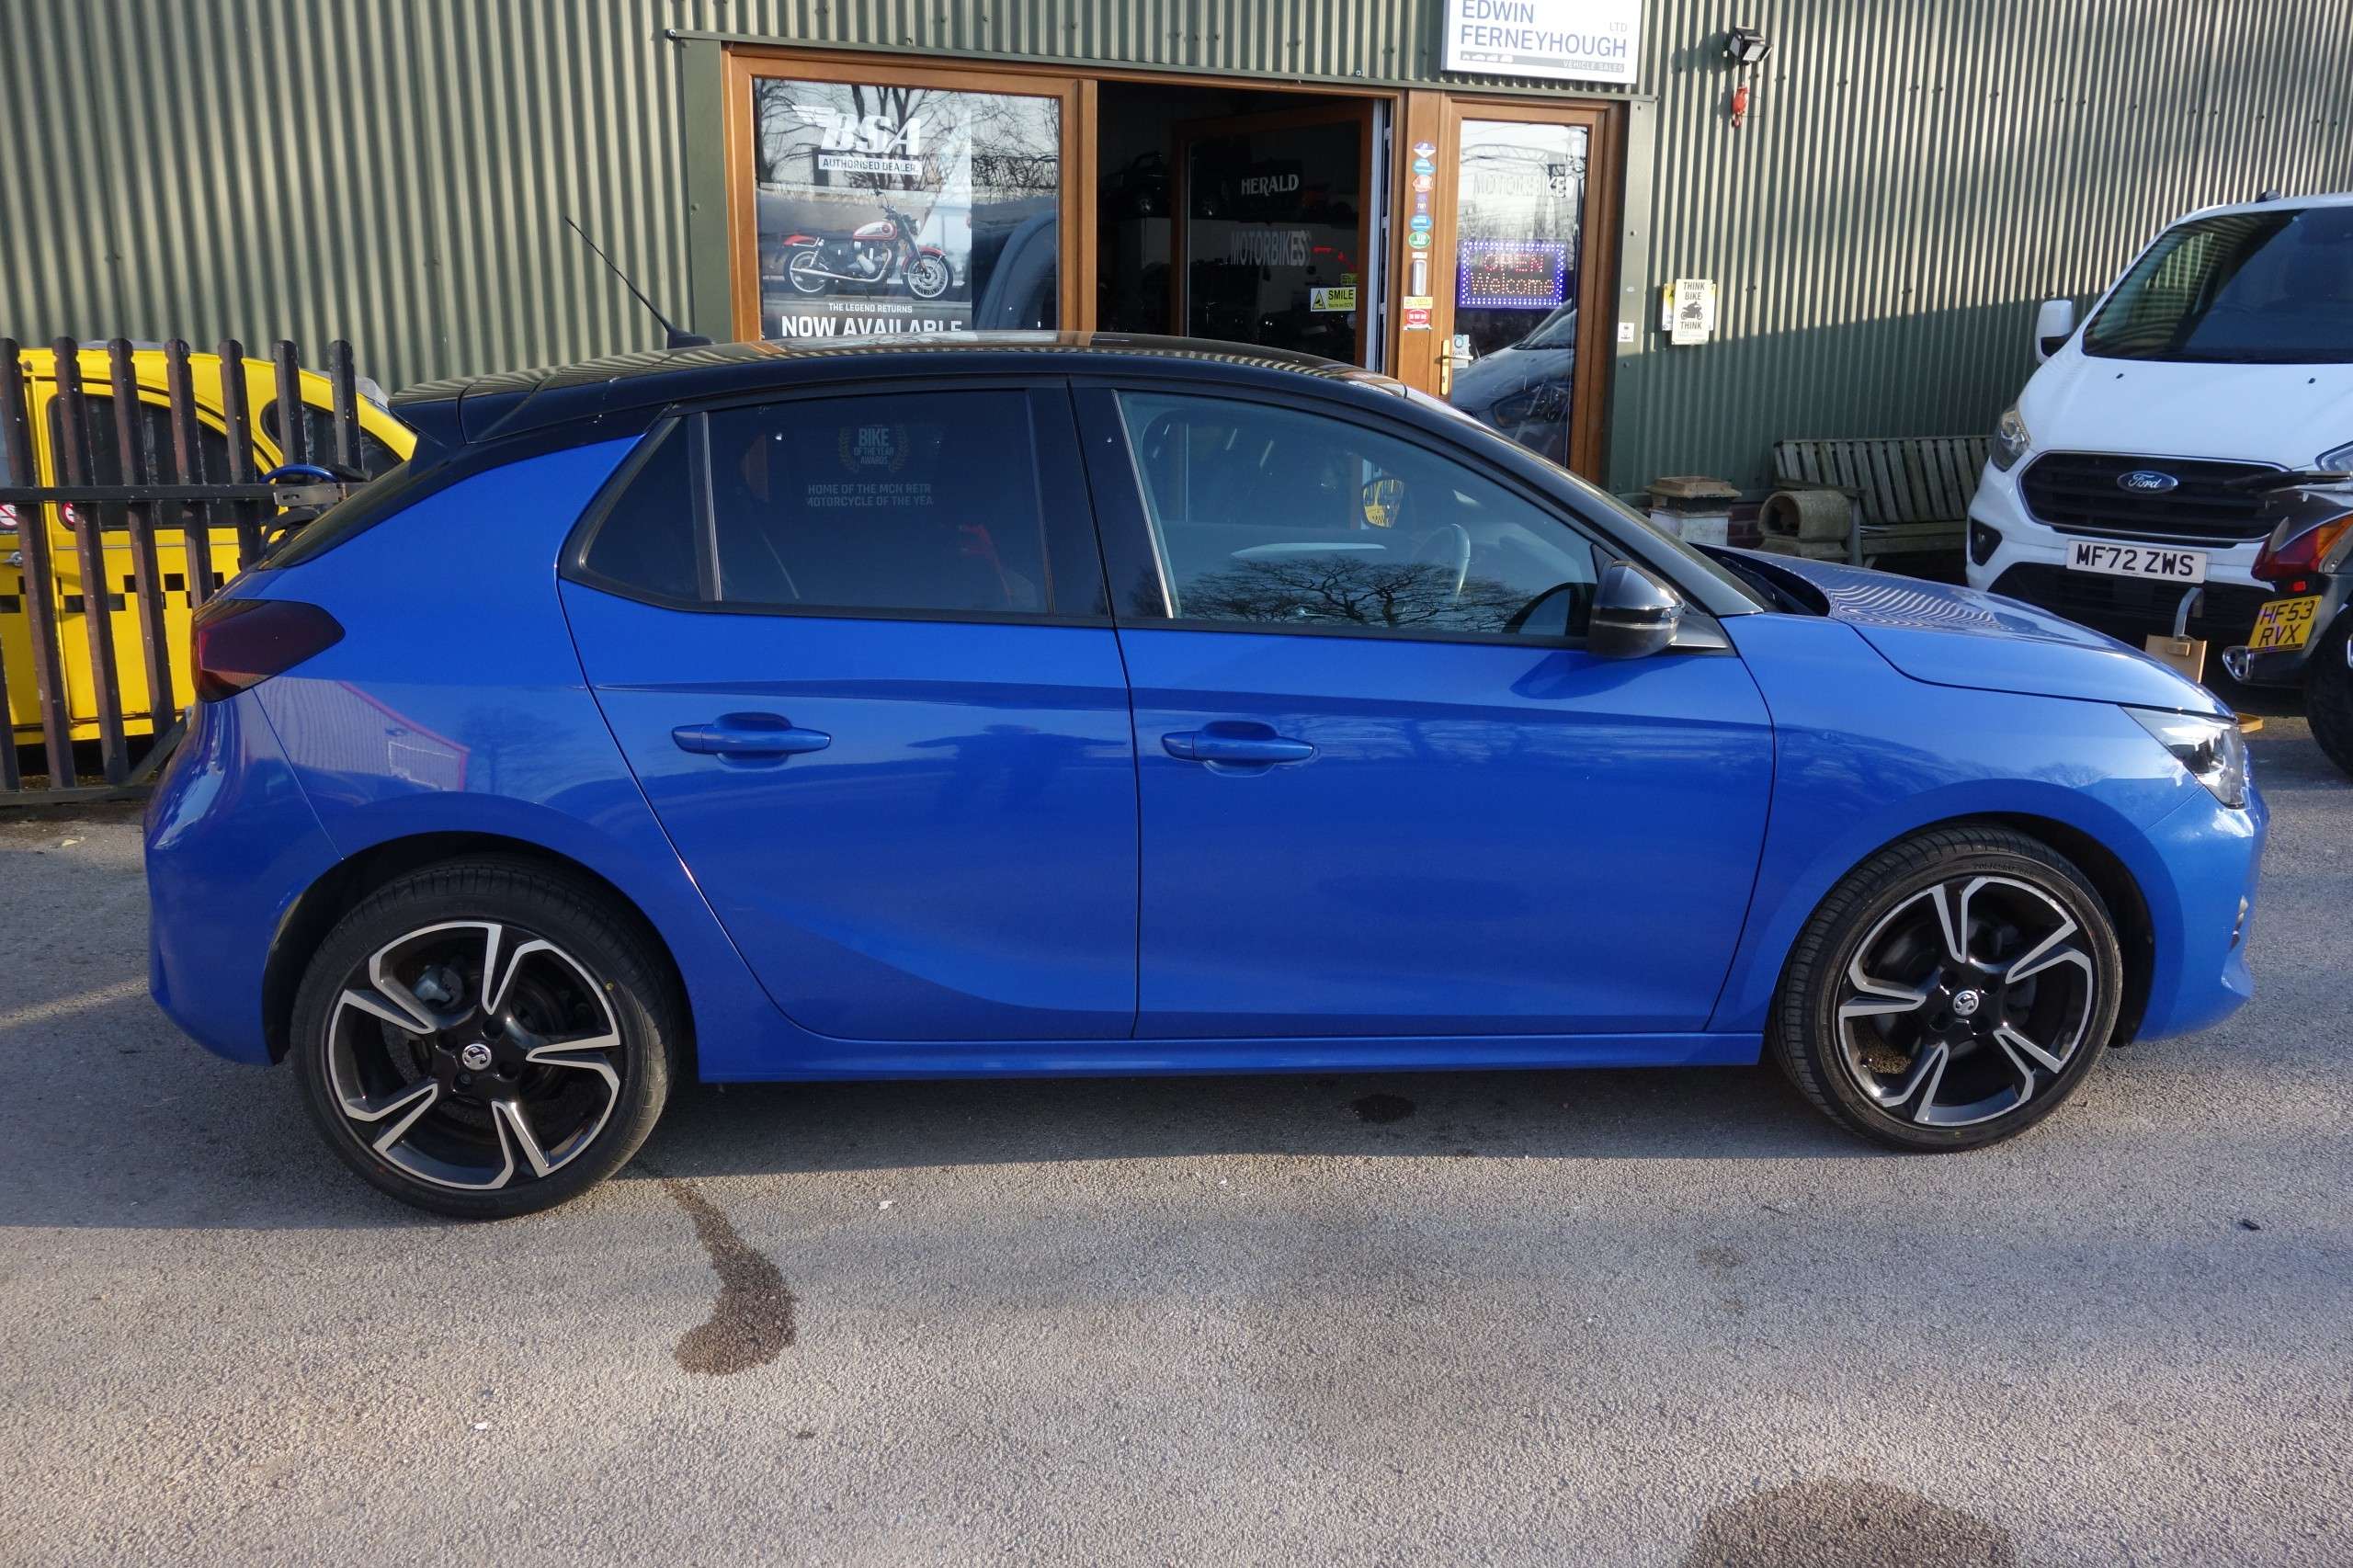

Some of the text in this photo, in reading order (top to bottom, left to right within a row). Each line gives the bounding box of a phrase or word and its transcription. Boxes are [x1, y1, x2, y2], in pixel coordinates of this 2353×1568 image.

[1462, 0, 1534, 23] EDWIN
[1609, 22, 1628, 32] LTD
[1461, 24, 1627, 58] FERNEYHOUGH
[1563, 59, 1624, 73] VEHICLE SALES
[821, 111, 921, 155] BSA
[823, 158, 917, 172] AUTHORISED DEALER
[1241, 174, 1300, 196] HERALD
[1230, 230, 1309, 266] MOTORBIKES
[1483, 254, 1544, 272] OPEN
[1471, 272, 1554, 294] Welcome
[1684, 281, 1705, 290] THINK
[1328, 290, 1354, 301] SMILE
[1685, 292, 1701, 301] BIKE
[829, 302, 913, 313] THE LEGEND RETURNS
[781, 315, 835, 337] NOW
[1680, 321, 1702, 329] THINK
[858, 427, 890, 447] BIKE
[808, 483, 839, 494] HOME
[841, 483, 854, 494] OF
[857, 483, 876, 494] THE
[2128, 472, 2162, 489] Ford
[876, 495, 889, 506] OF
[891, 495, 912, 506] THE
[2075, 543, 2195, 577] MF72 ZWS
[2259, 600, 2315, 626] HF53
[2257, 624, 2302, 647] RVX
